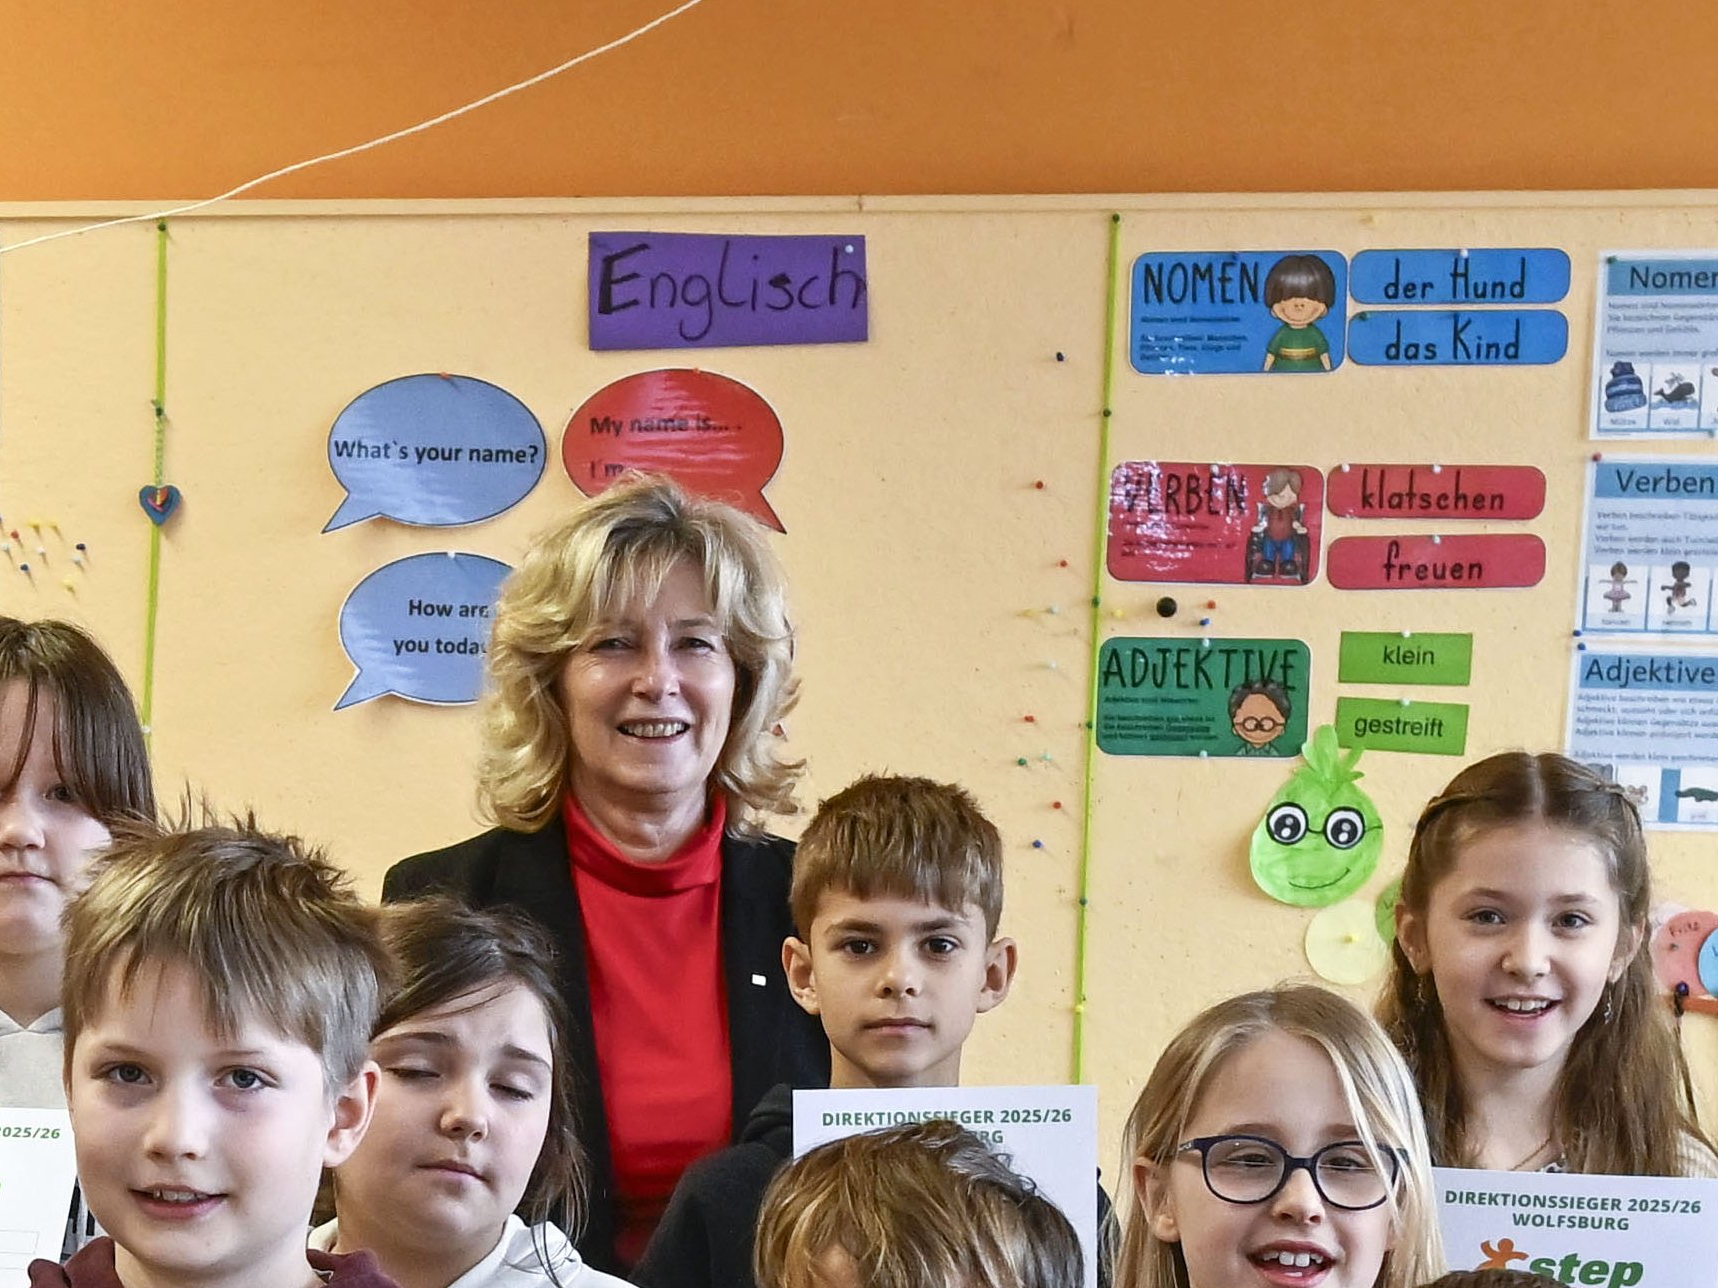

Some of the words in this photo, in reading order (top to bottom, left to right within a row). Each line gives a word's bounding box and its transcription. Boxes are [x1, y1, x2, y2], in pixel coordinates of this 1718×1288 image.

[598, 241, 864, 341] Englisch
[1143, 261, 1260, 305] NOMEN
[1382, 260, 1437, 300] der
[1449, 258, 1526, 300] Hund
[1384, 317, 1438, 359] das
[1453, 317, 1522, 361] Kind
[590, 416, 623, 437] My
[630, 416, 689, 434] name
[415, 444, 463, 466] your
[468, 442, 539, 466] name?
[1124, 473, 1247, 516] VERBEN
[1361, 469, 1505, 511] klatschen
[1613, 469, 1715, 495] Verben
[1382, 539, 1483, 581] freuen
[408, 599, 450, 619] How
[393, 638, 428, 659] you
[435, 636, 489, 655] toda
[1382, 644, 1435, 667] klein
[1102, 650, 1297, 692] ADJEKTIVE
[1585, 656, 1717, 688] Adjektive
[1353, 714, 1444, 742] gestreift
